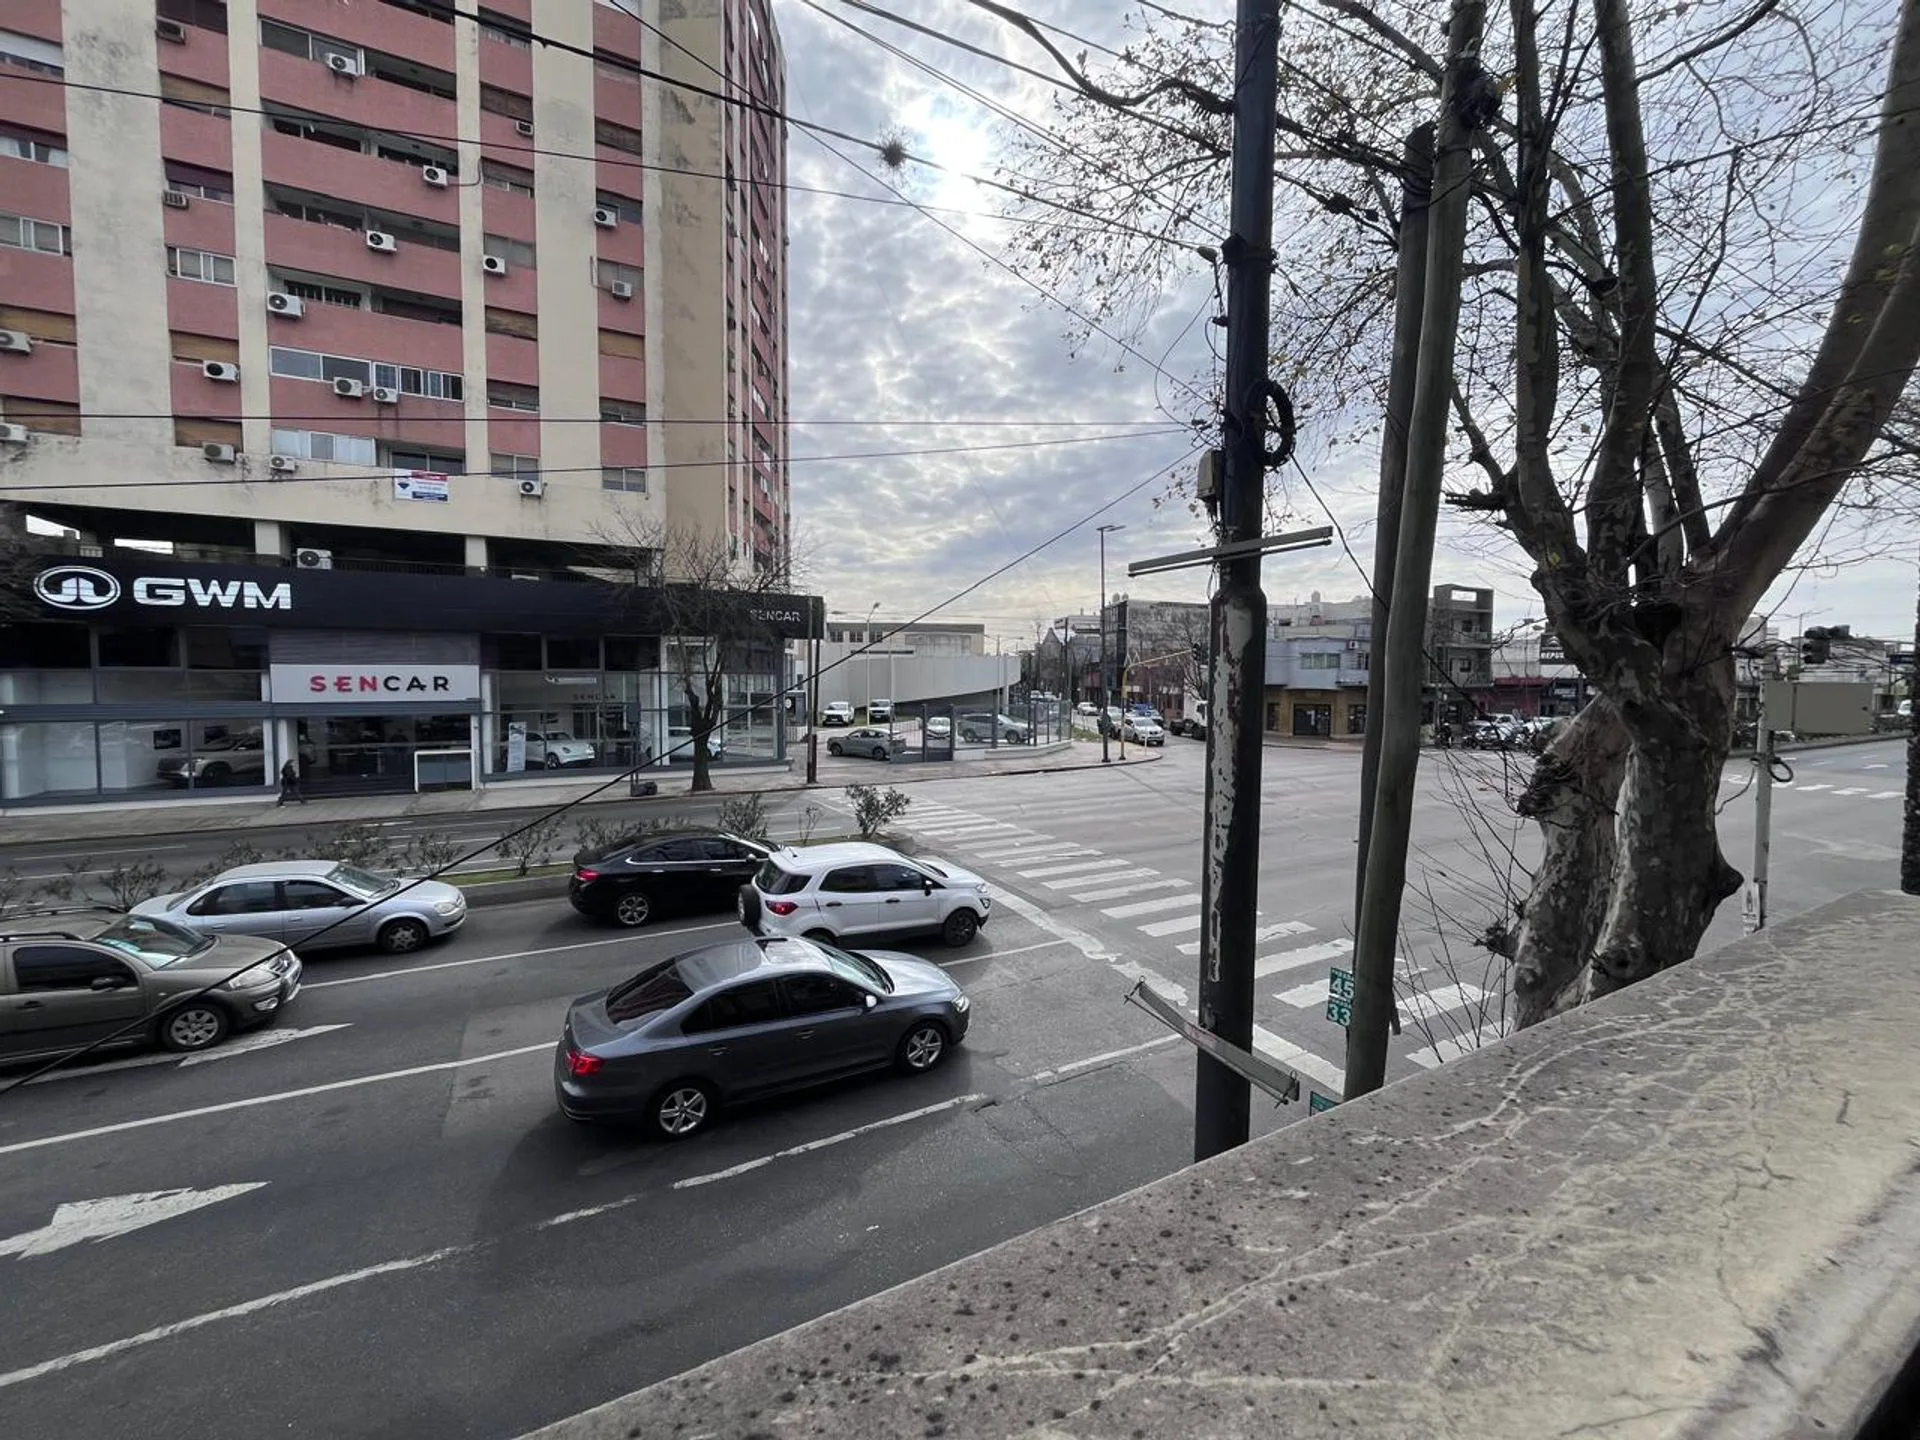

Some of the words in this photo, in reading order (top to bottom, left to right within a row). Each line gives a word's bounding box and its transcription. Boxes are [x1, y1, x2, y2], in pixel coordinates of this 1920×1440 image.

[133, 577, 292, 609] GWM
[310, 675, 450, 692] SENCAR
[1330, 978, 1354, 999] 45
[1327, 1003, 1351, 1026] 33
